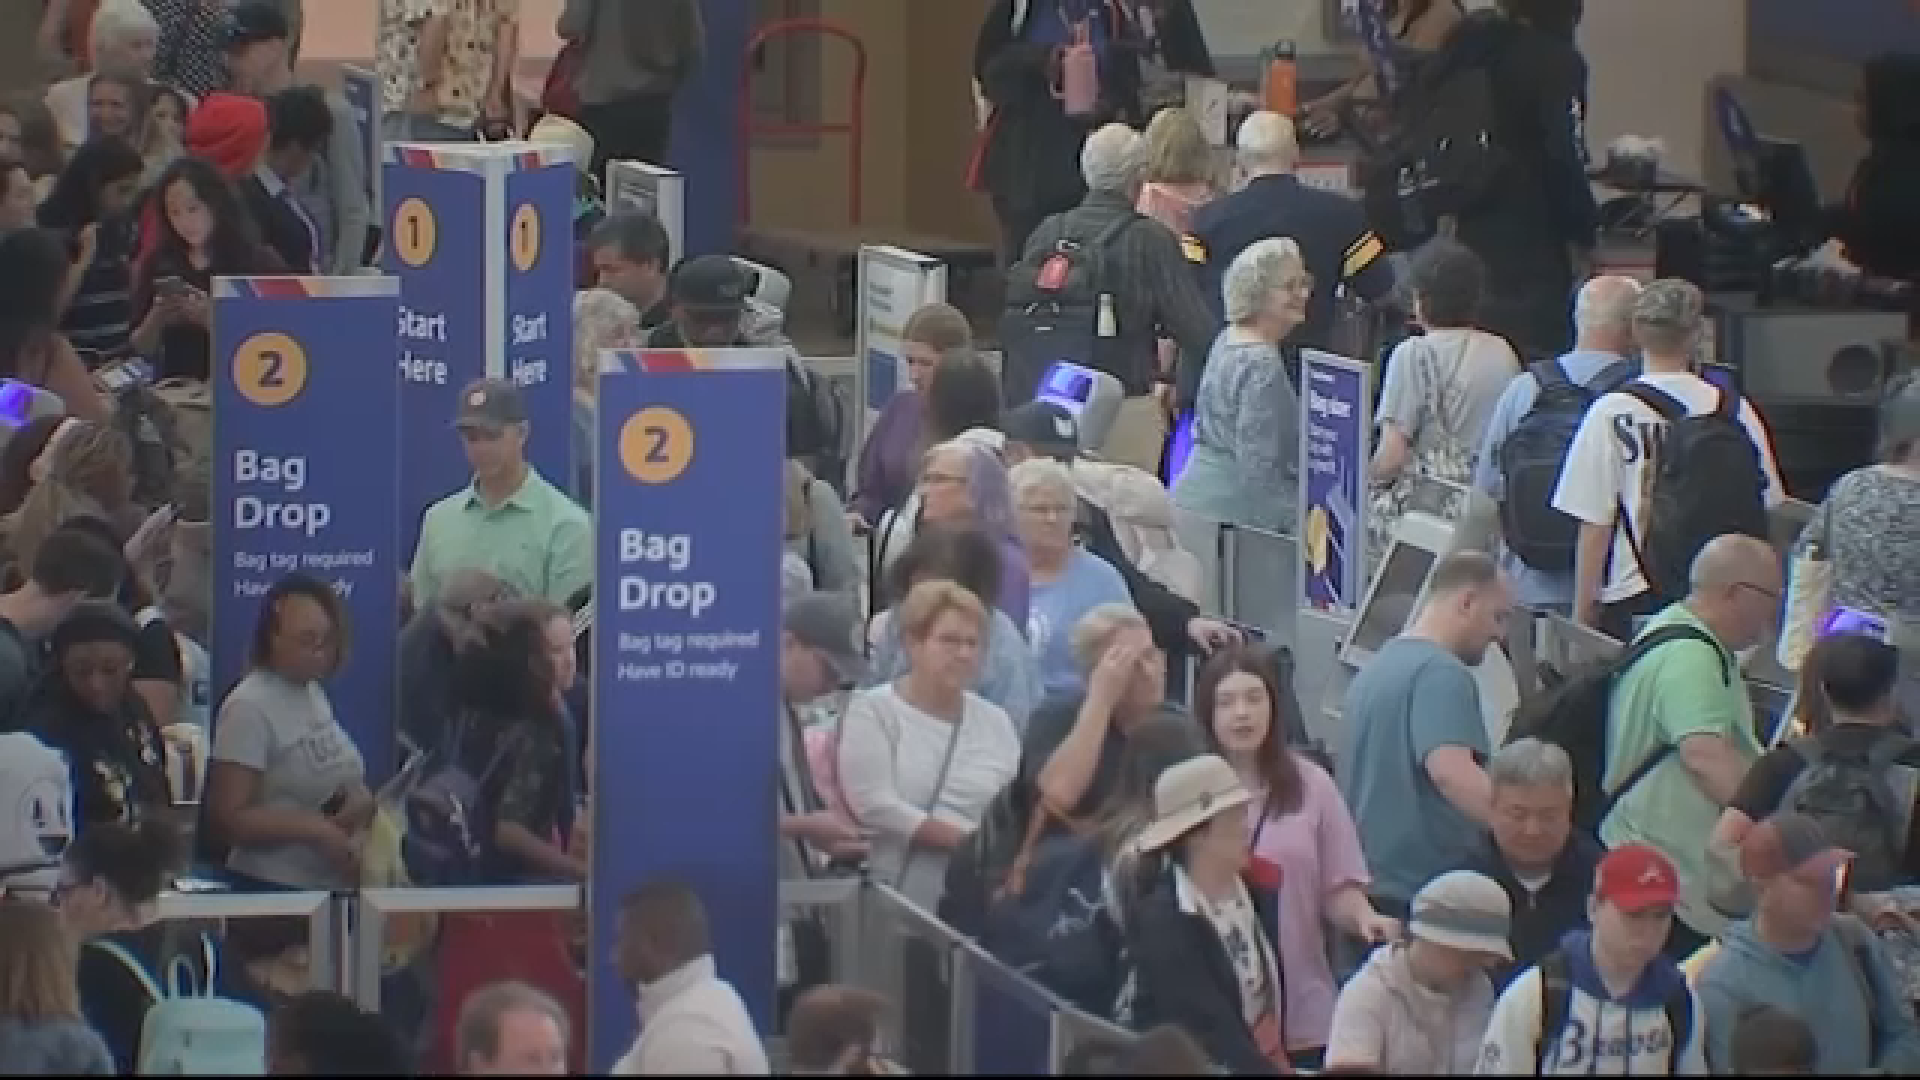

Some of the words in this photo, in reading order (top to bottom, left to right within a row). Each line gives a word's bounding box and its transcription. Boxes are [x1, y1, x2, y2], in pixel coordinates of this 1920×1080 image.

[408, 215, 419, 249] 1
[258, 350, 284, 388] 2
[644, 425, 670, 463] 2
[235, 449, 304, 490] Bag
[235, 497, 331, 538] Drop
[233, 551, 266, 573] Bag
[269, 551, 299, 573] tag
[302, 548, 374, 571] required
[620, 527, 691, 571] Bag
[620, 575, 716, 619] Drop
[617, 632, 652, 655] Bag
[653, 634, 685, 655] tag
[686, 629, 760, 652] required
[617, 661, 662, 681] Have
[665, 660, 686, 679] ID
[688, 658, 740, 683] ready
